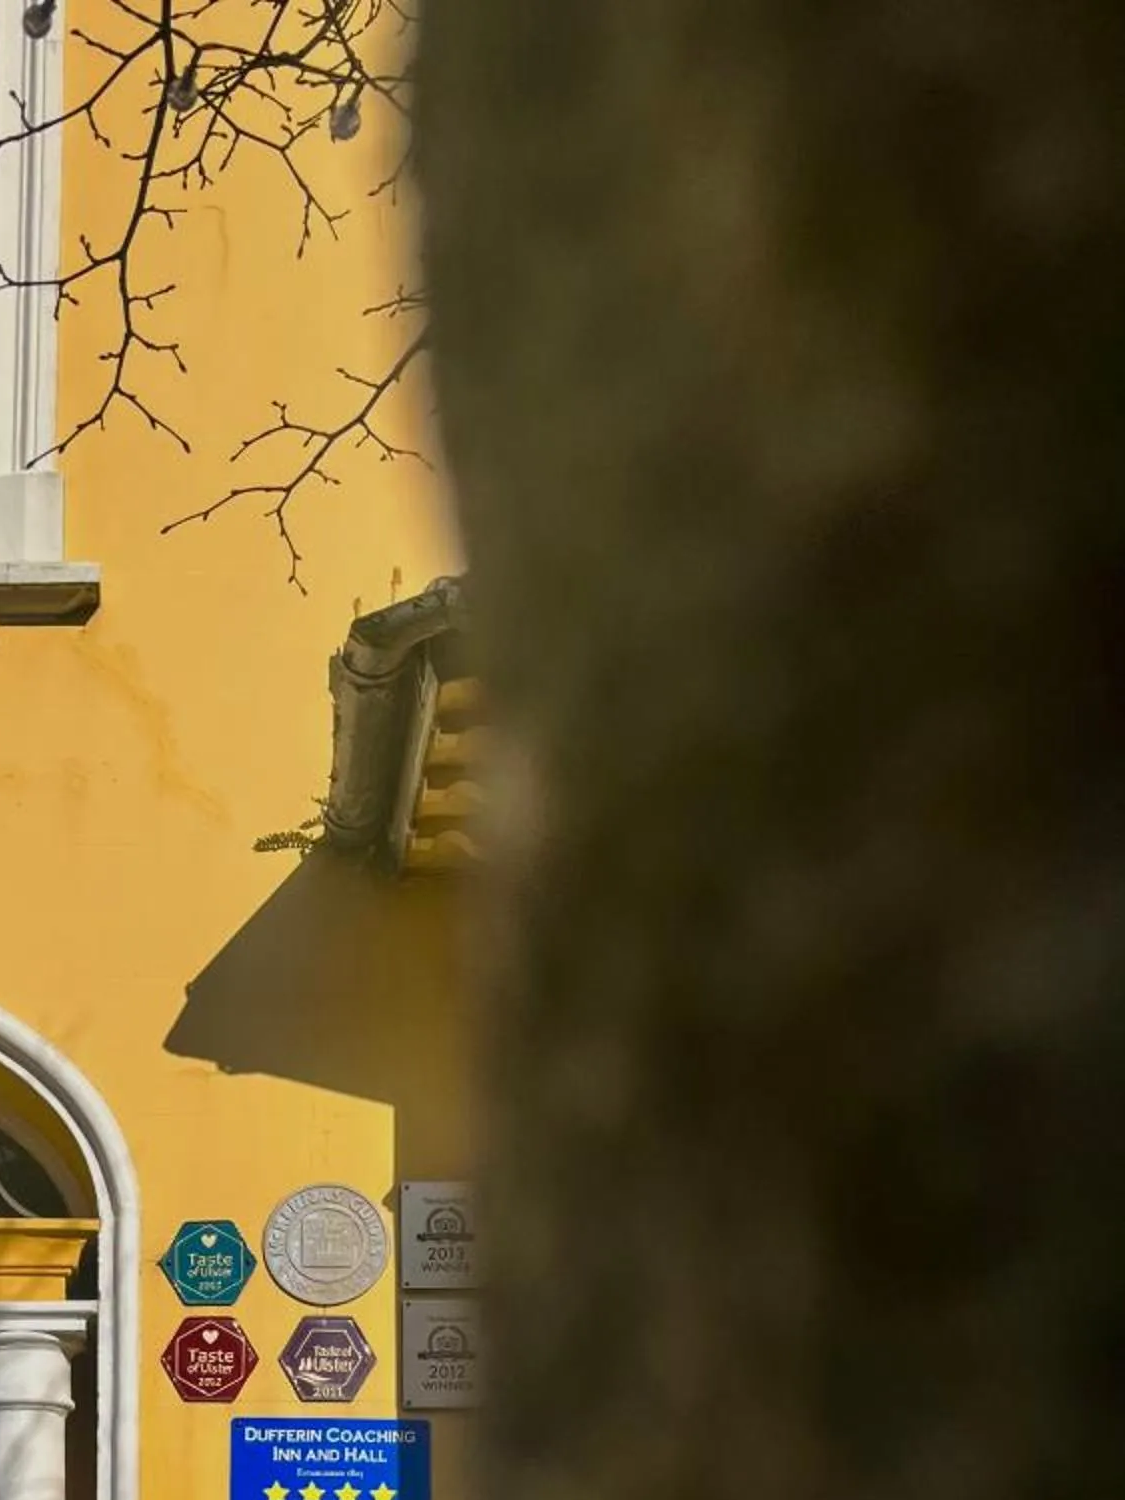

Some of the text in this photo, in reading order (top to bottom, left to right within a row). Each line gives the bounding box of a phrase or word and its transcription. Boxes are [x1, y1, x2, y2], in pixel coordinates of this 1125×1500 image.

[187, 1253, 233, 1266] Taste
[187, 1347, 234, 1363] Taste
[187, 1363, 234, 1375] of Ulster
[313, 1357, 354, 1372] Ulster
[428, 1365, 465, 1379] 2012
[312, 1386, 343, 1398] 2011
[244, 1426, 416, 1444] DUFFERIN COACHING
[272, 1446, 388, 1463] INN AND HALL
